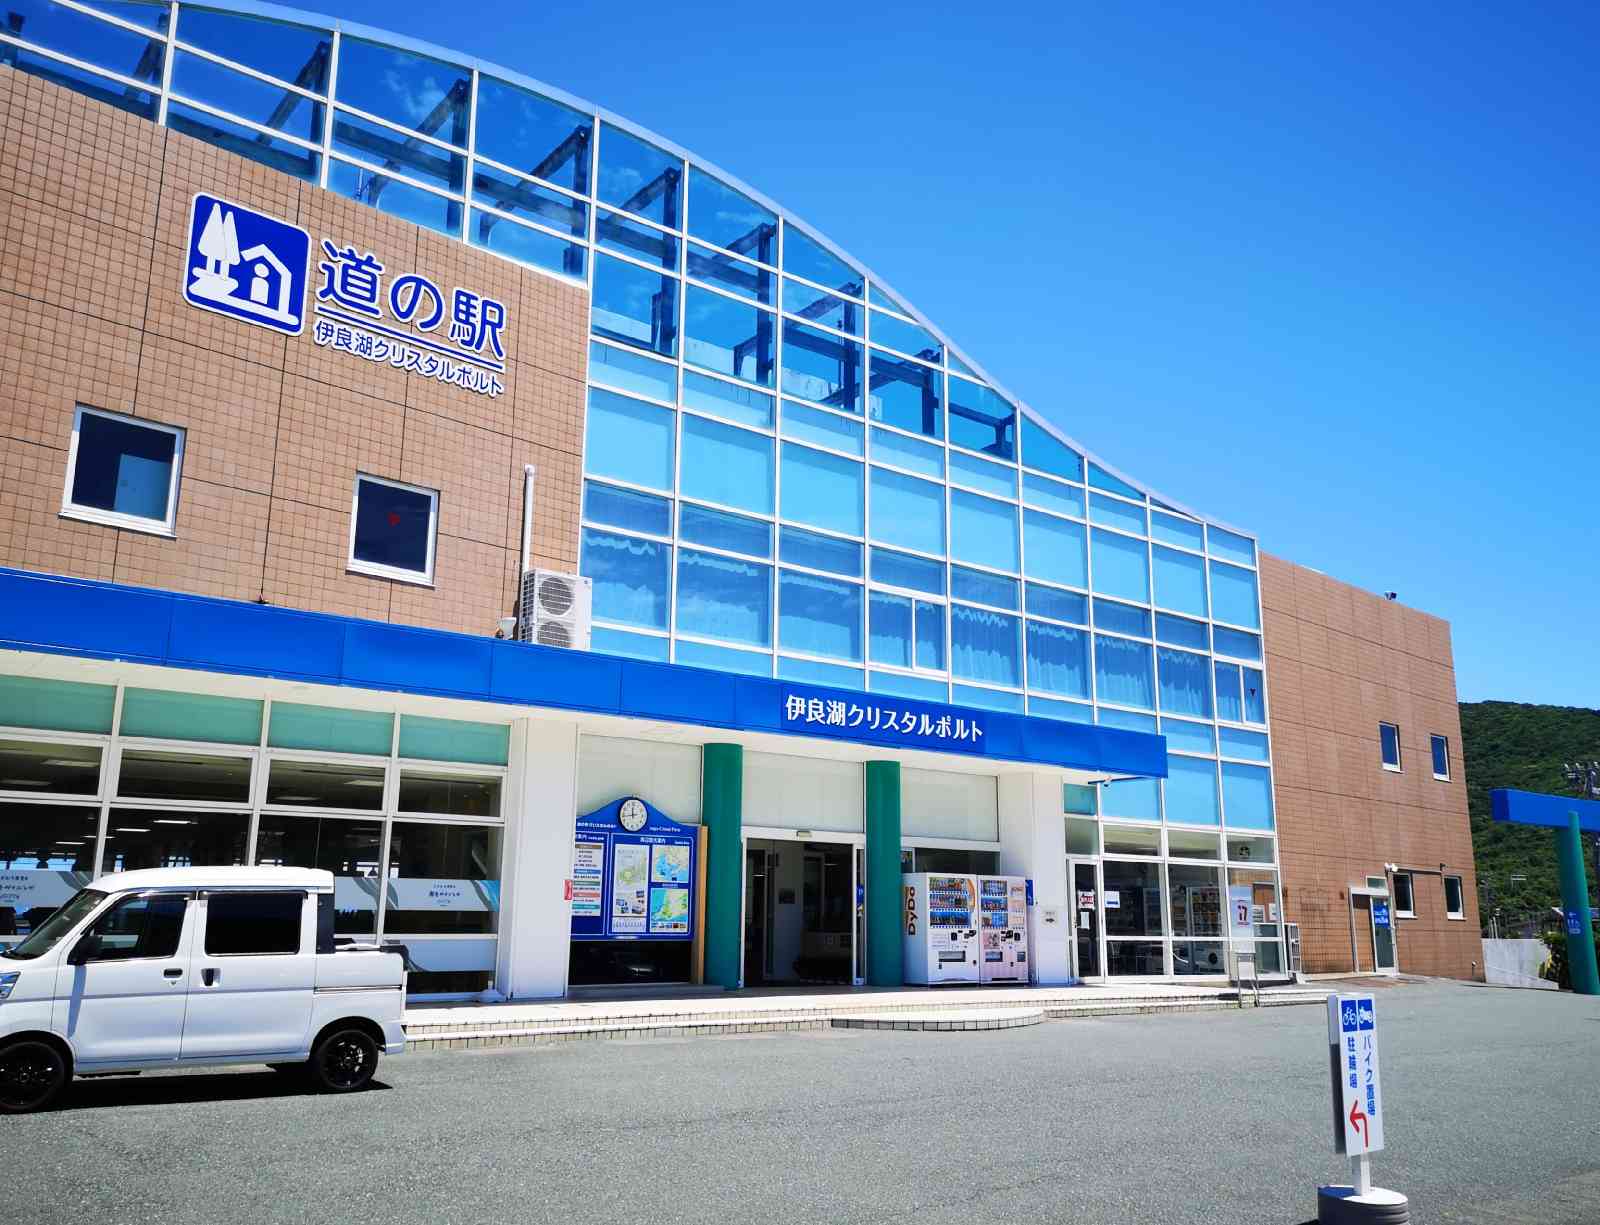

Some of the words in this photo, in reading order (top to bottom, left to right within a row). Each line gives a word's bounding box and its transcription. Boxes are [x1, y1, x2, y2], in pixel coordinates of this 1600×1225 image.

[316, 239, 506, 359] 道の駅
[785, 694, 984, 743] 伊良湖クリスタルポルト
